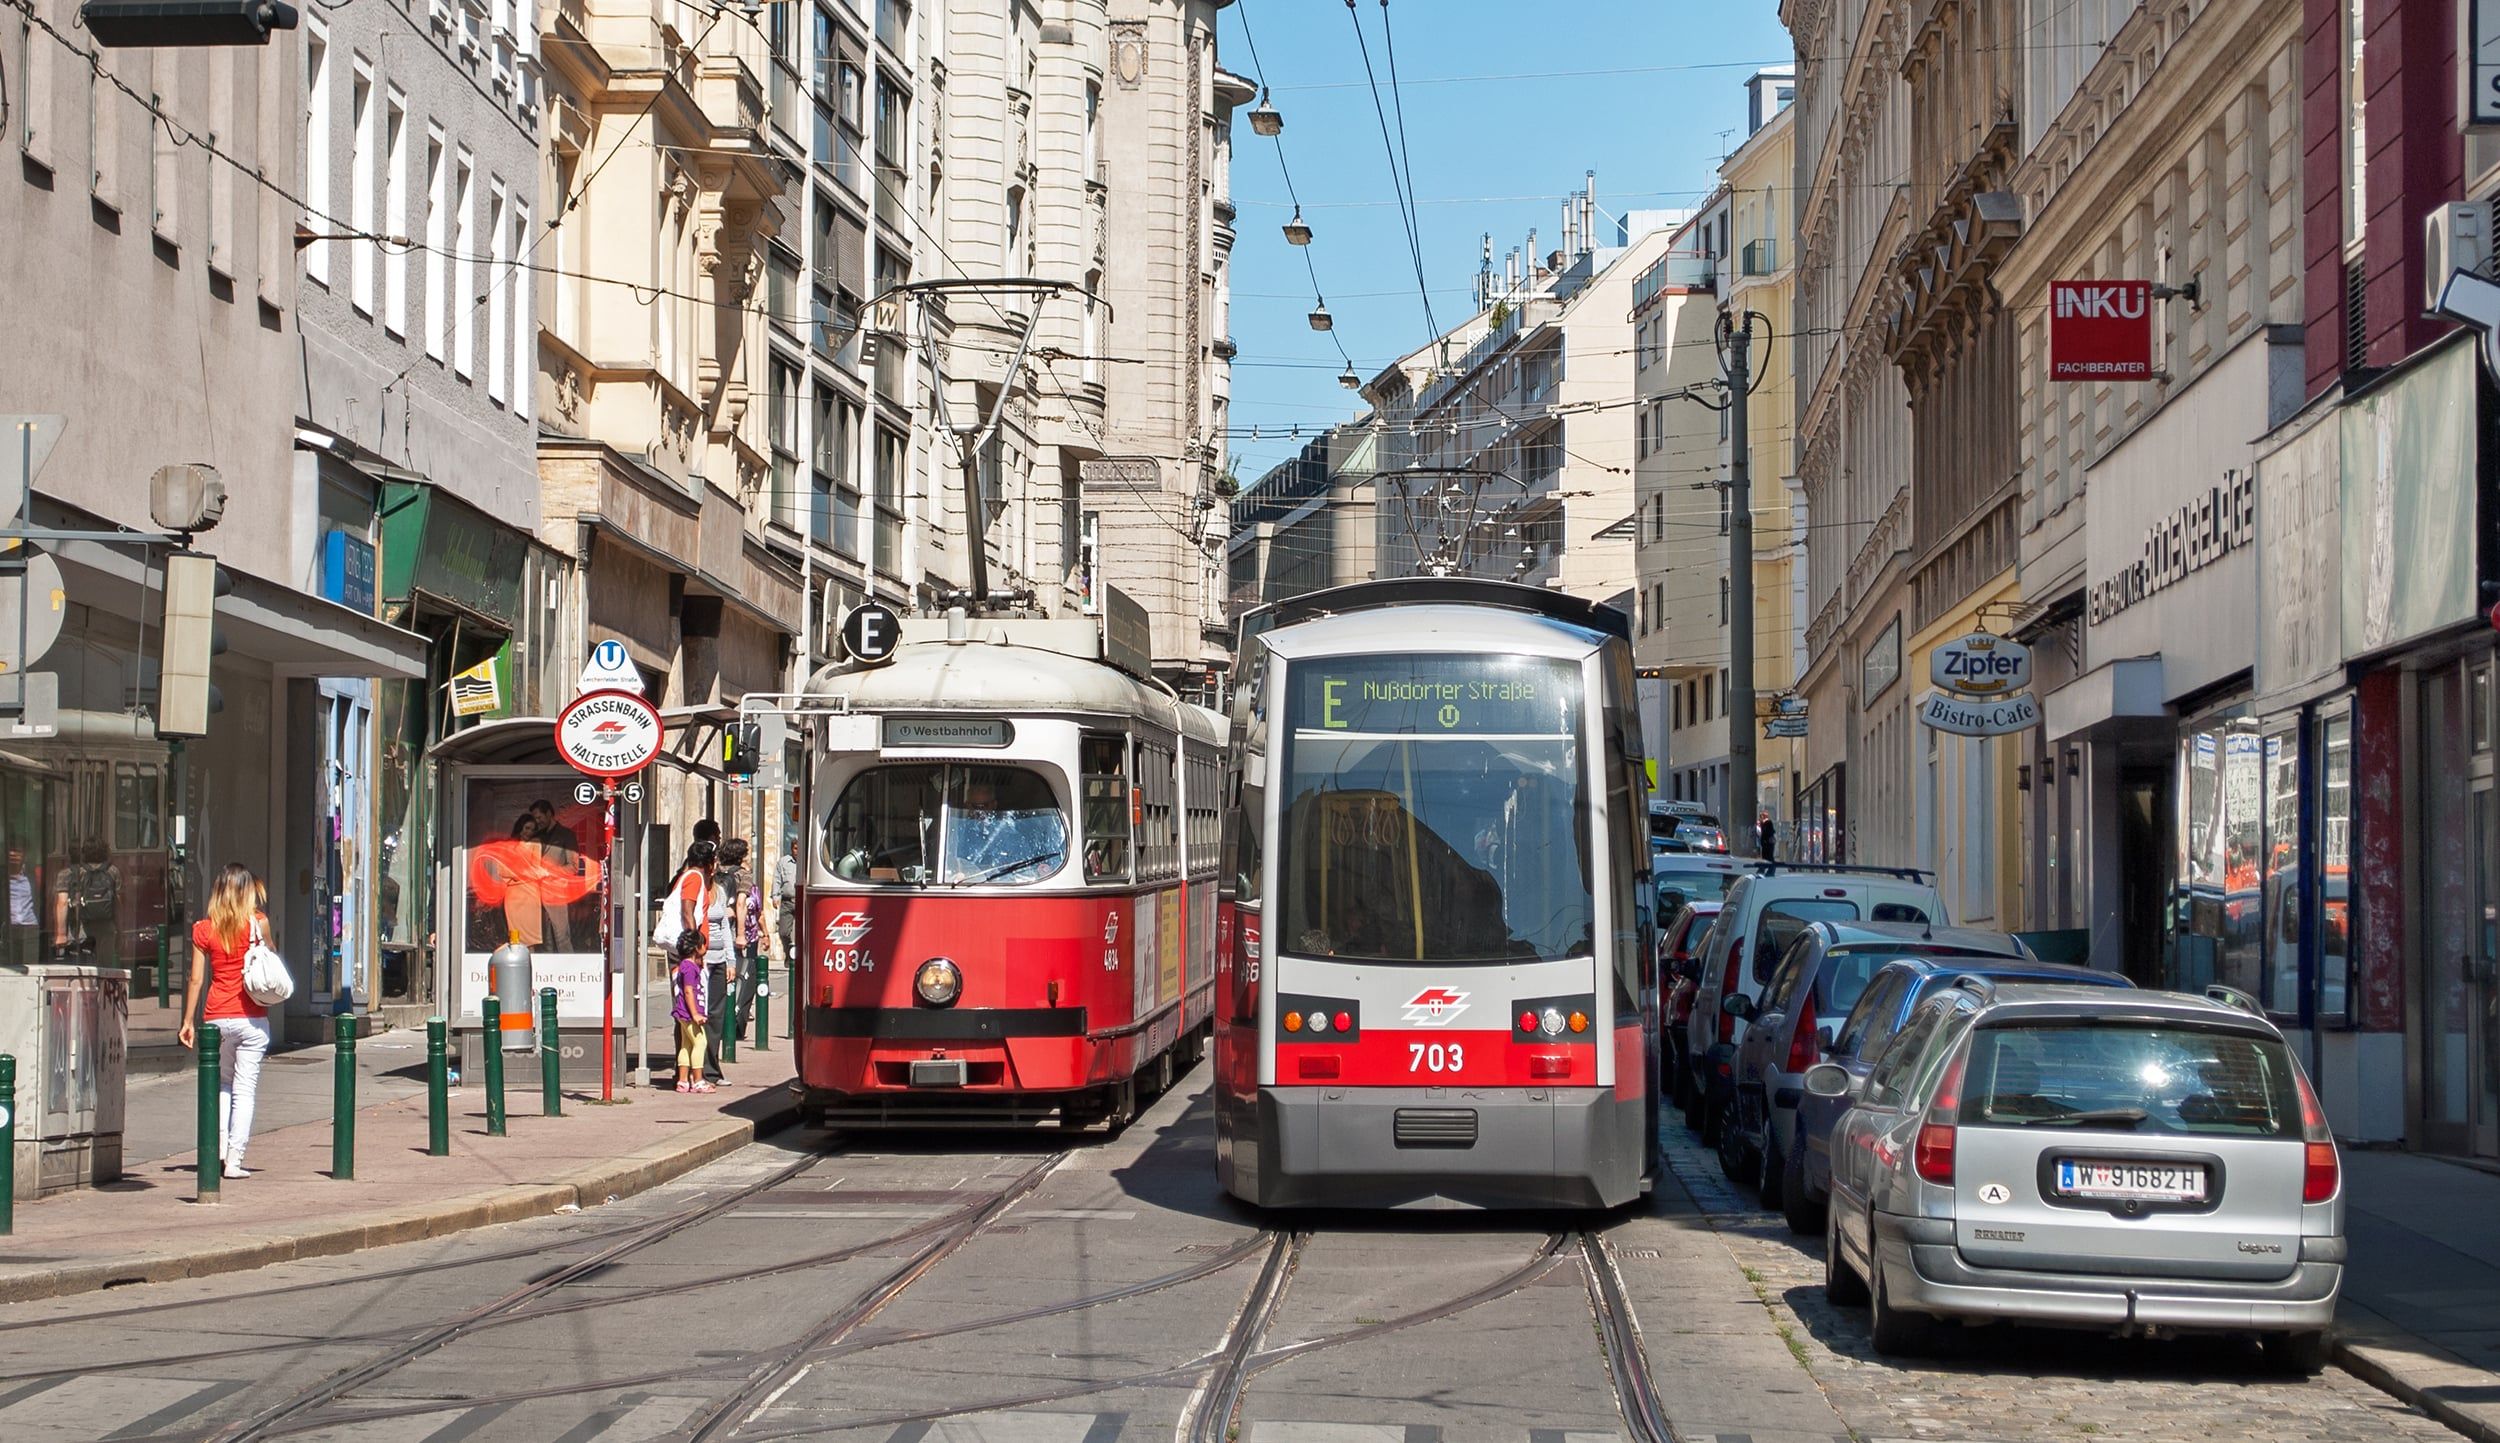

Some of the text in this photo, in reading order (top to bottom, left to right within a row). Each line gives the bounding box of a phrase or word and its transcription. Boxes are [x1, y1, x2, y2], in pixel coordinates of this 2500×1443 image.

[2056, 287, 2145, 319] INKU
[2057, 362, 2145, 373] FACHBERATER
[861, 612, 883, 655] E
[1943, 651, 2023, 681] Zipfer
[567, 700, 652, 730] STRASSENBAHN
[1323, 680, 1535, 728] E Nußdorfer Straße
[913, 726, 993, 737] Westbahnhof
[570, 742, 648, 768] HALTESTELLE
[578, 785, 591, 801] E
[628, 785, 641, 801] 5
[823, 949, 875, 973] 4834
[1103, 949, 1119, 971] 4834
[535, 971, 553, 983] hat
[558, 971, 576, 983] ein
[1408, 1043, 1464, 1072] 703
[2078, 1165, 2195, 1191] W 91682 H
[1987, 1186, 2002, 1201] A
